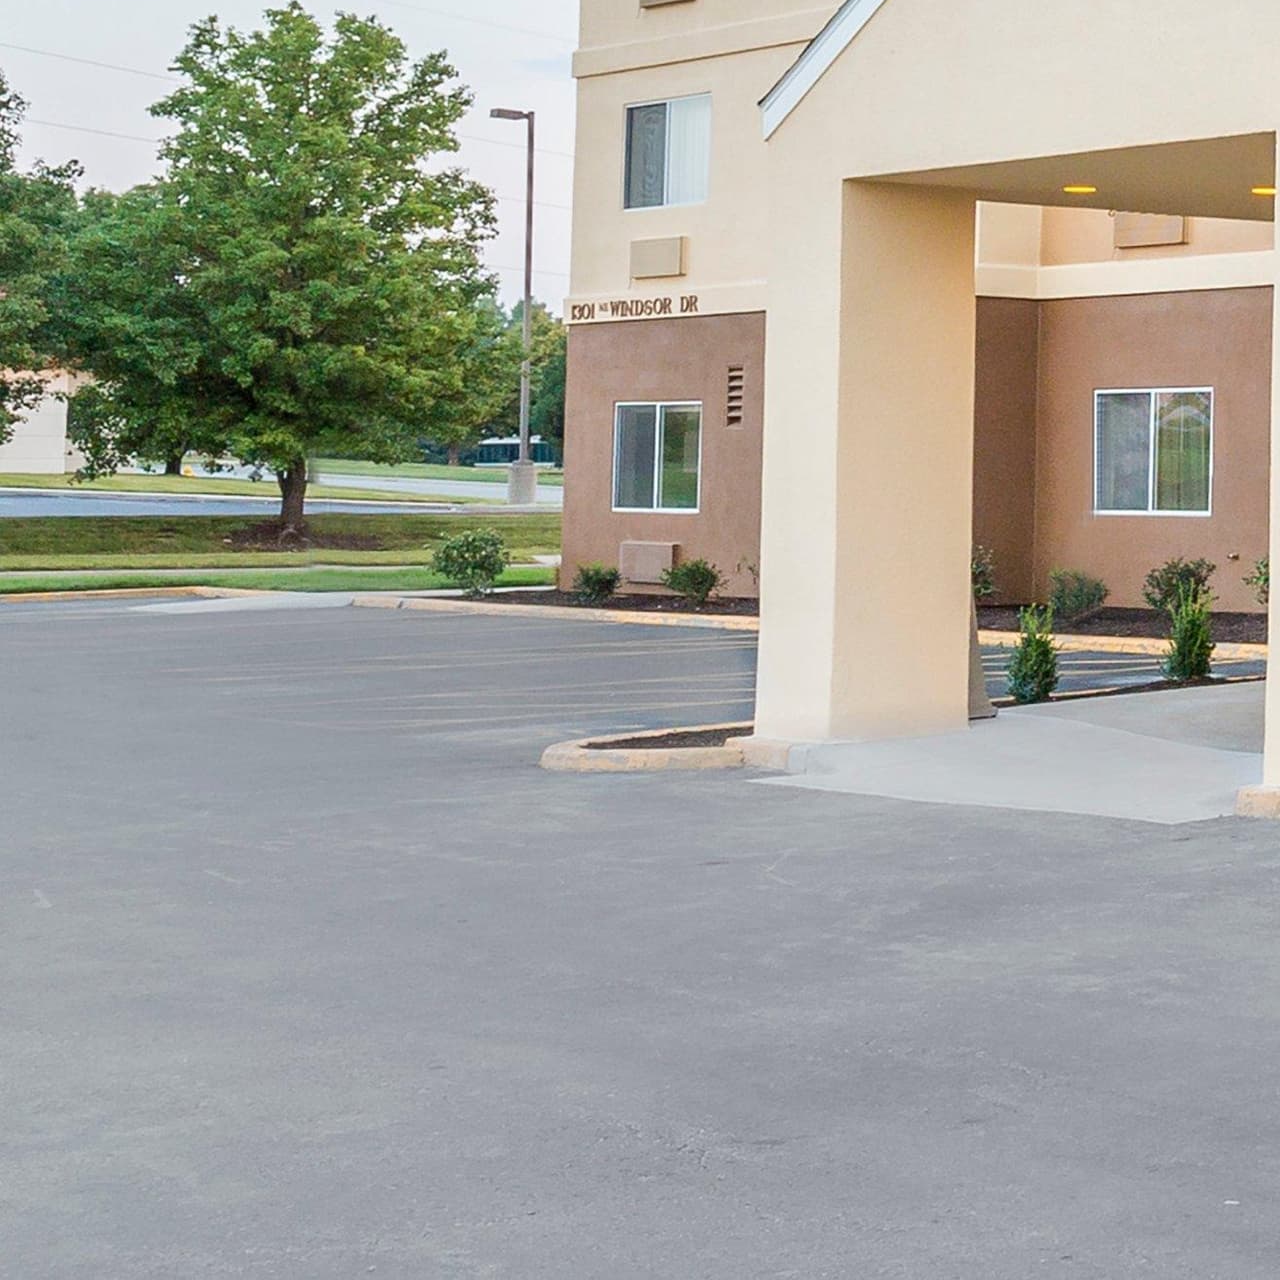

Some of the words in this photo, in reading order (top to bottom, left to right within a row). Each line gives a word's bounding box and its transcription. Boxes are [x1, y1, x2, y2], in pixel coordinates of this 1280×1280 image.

[571, 303, 595, 320] 1301
[610, 297, 672, 317] WINDSOR
[680, 295, 699, 313] DR
